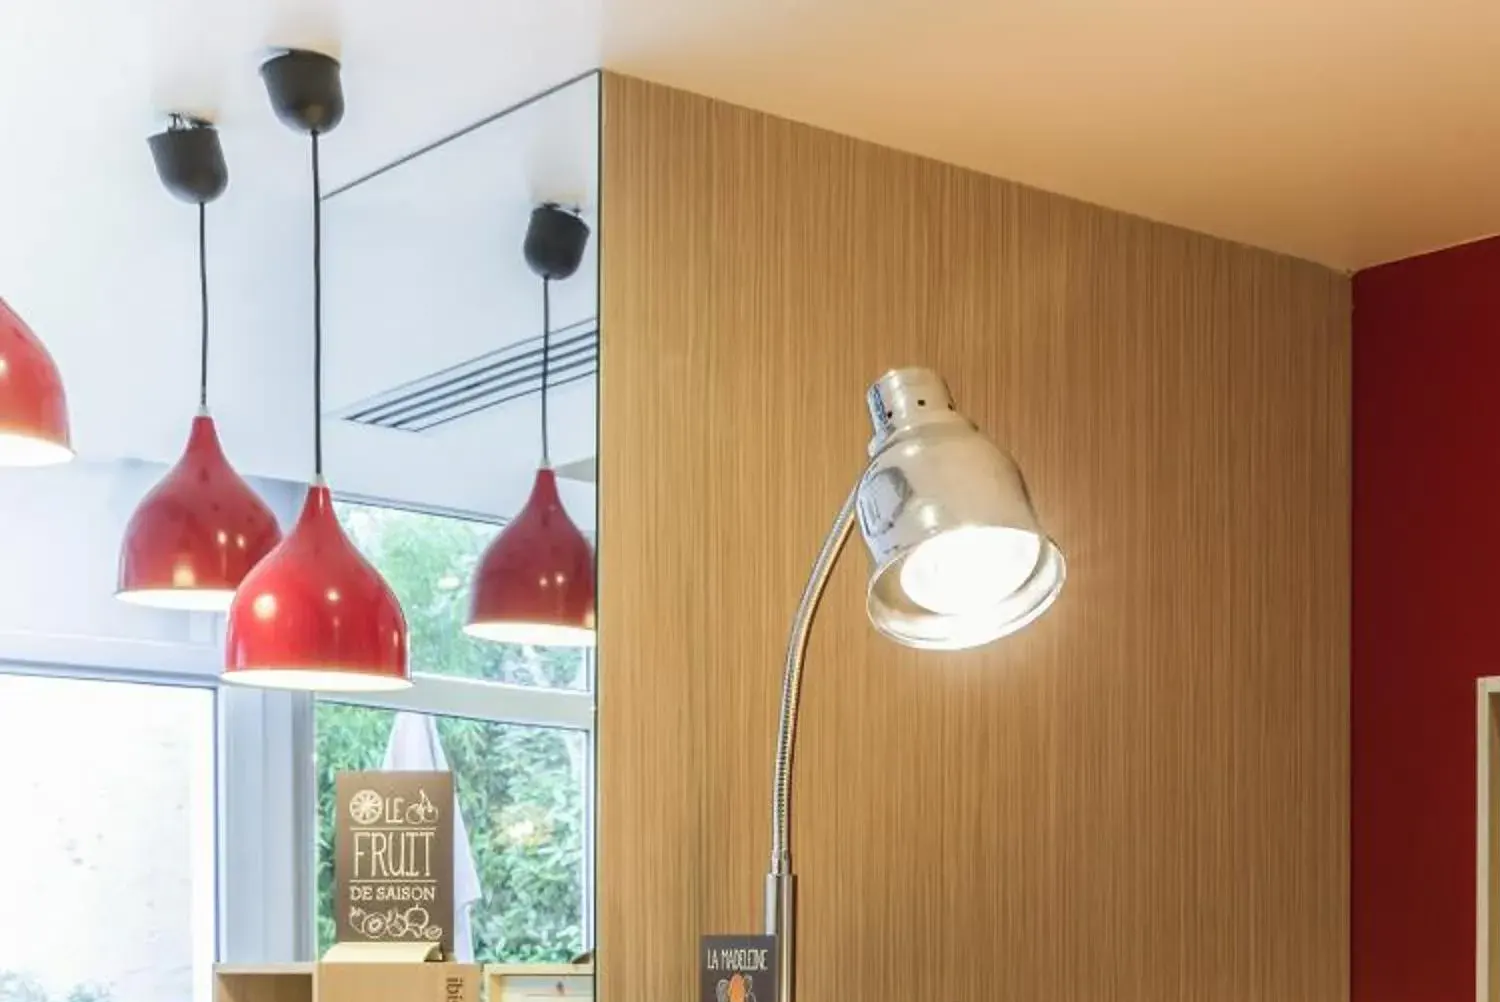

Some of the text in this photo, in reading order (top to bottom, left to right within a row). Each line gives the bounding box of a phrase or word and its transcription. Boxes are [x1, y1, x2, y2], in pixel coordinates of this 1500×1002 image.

[385, 797, 403, 824] LE
[354, 831, 435, 878] FRUIT
[350, 885, 436, 901] DE SAISON
[706, 948, 769, 972] LA MADELEINE
